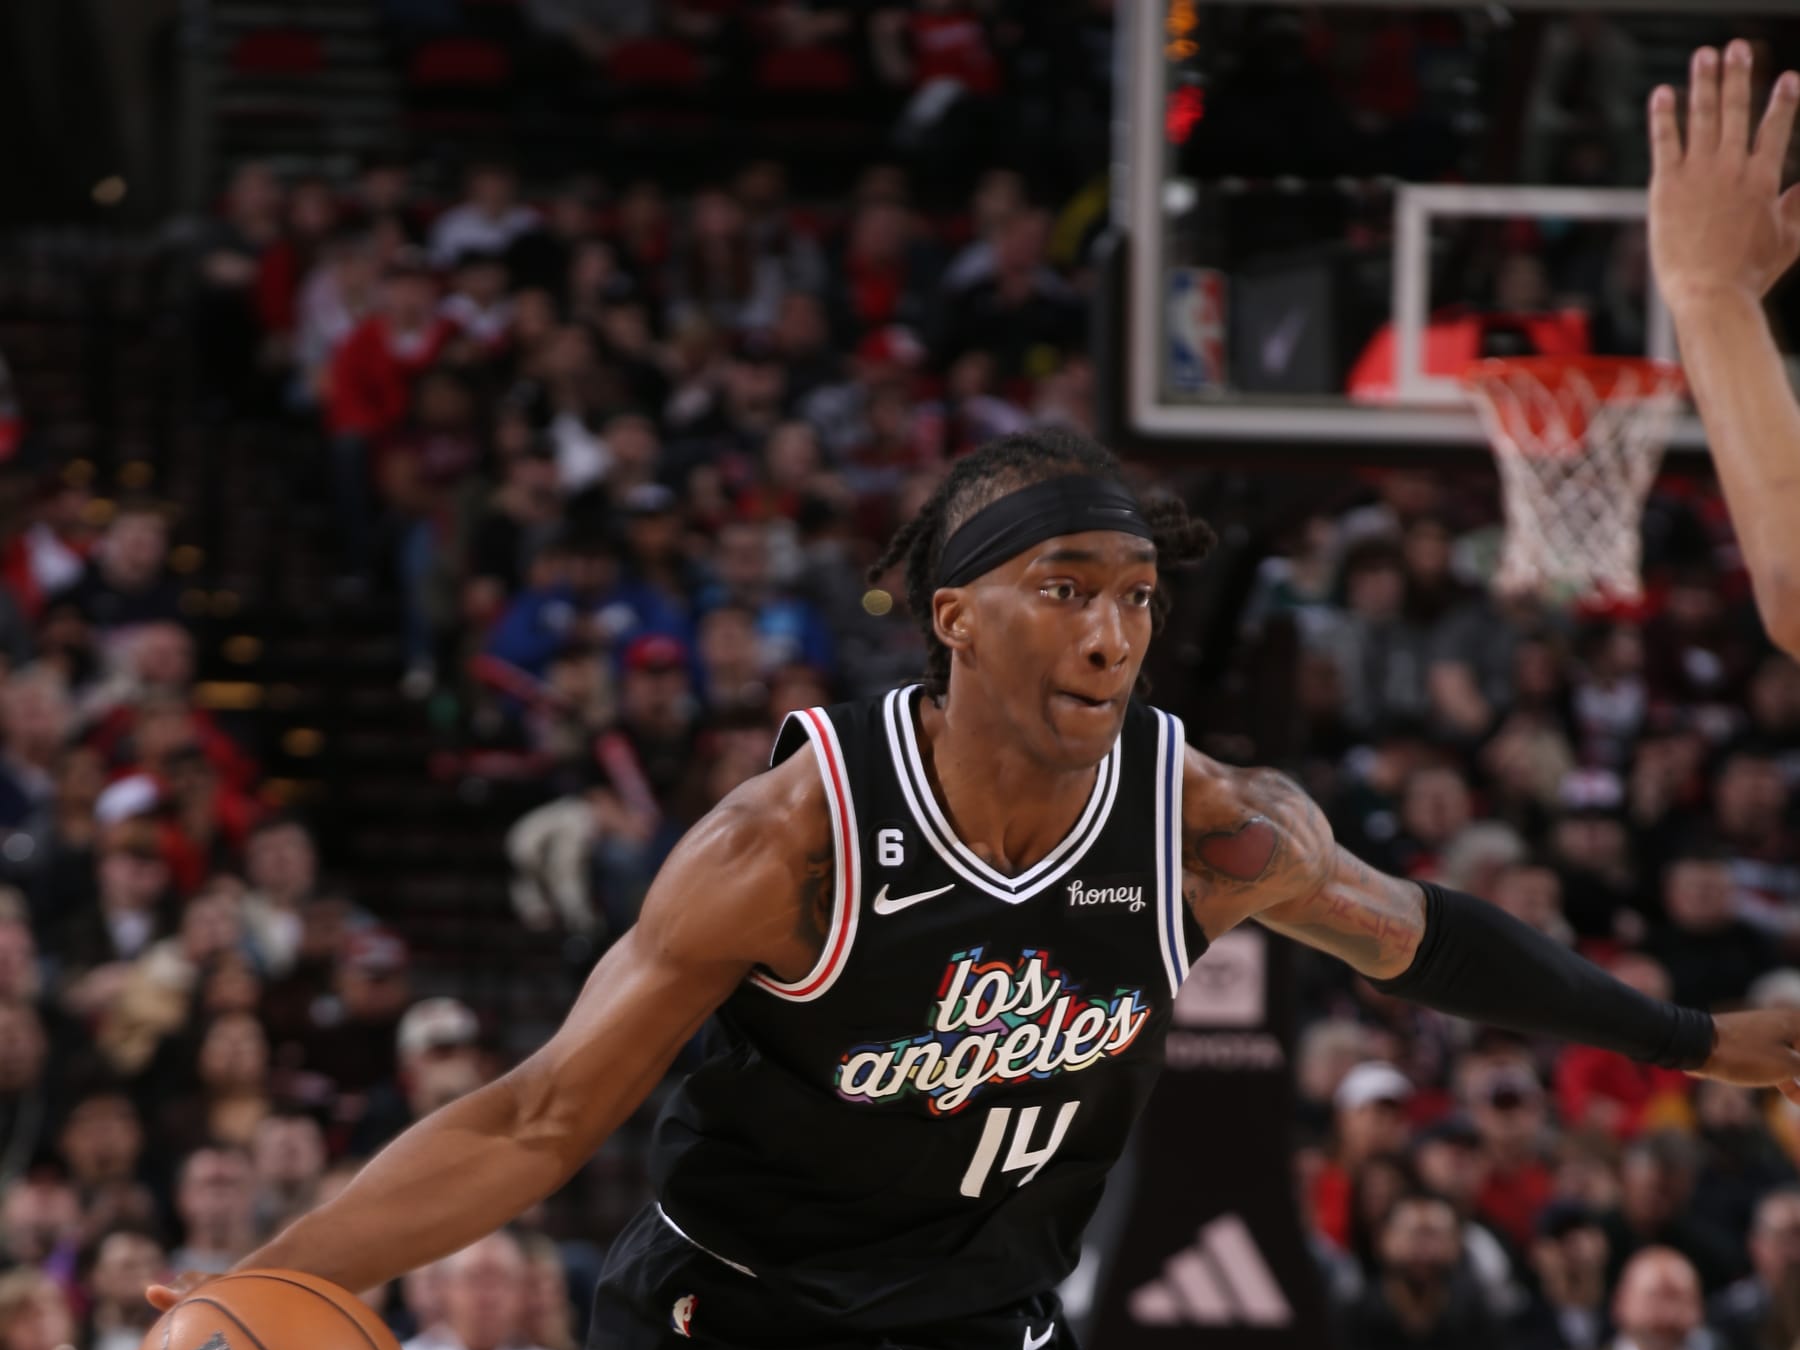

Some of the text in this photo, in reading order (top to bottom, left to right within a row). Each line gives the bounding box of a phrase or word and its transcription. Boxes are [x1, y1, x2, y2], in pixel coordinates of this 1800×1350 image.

[878, 828, 904, 866] 6
[1067, 880, 1147, 912] honey
[936, 957, 1061, 1032] los
[839, 995, 1146, 1111] angeles
[960, 1101, 1080, 1198] 14
